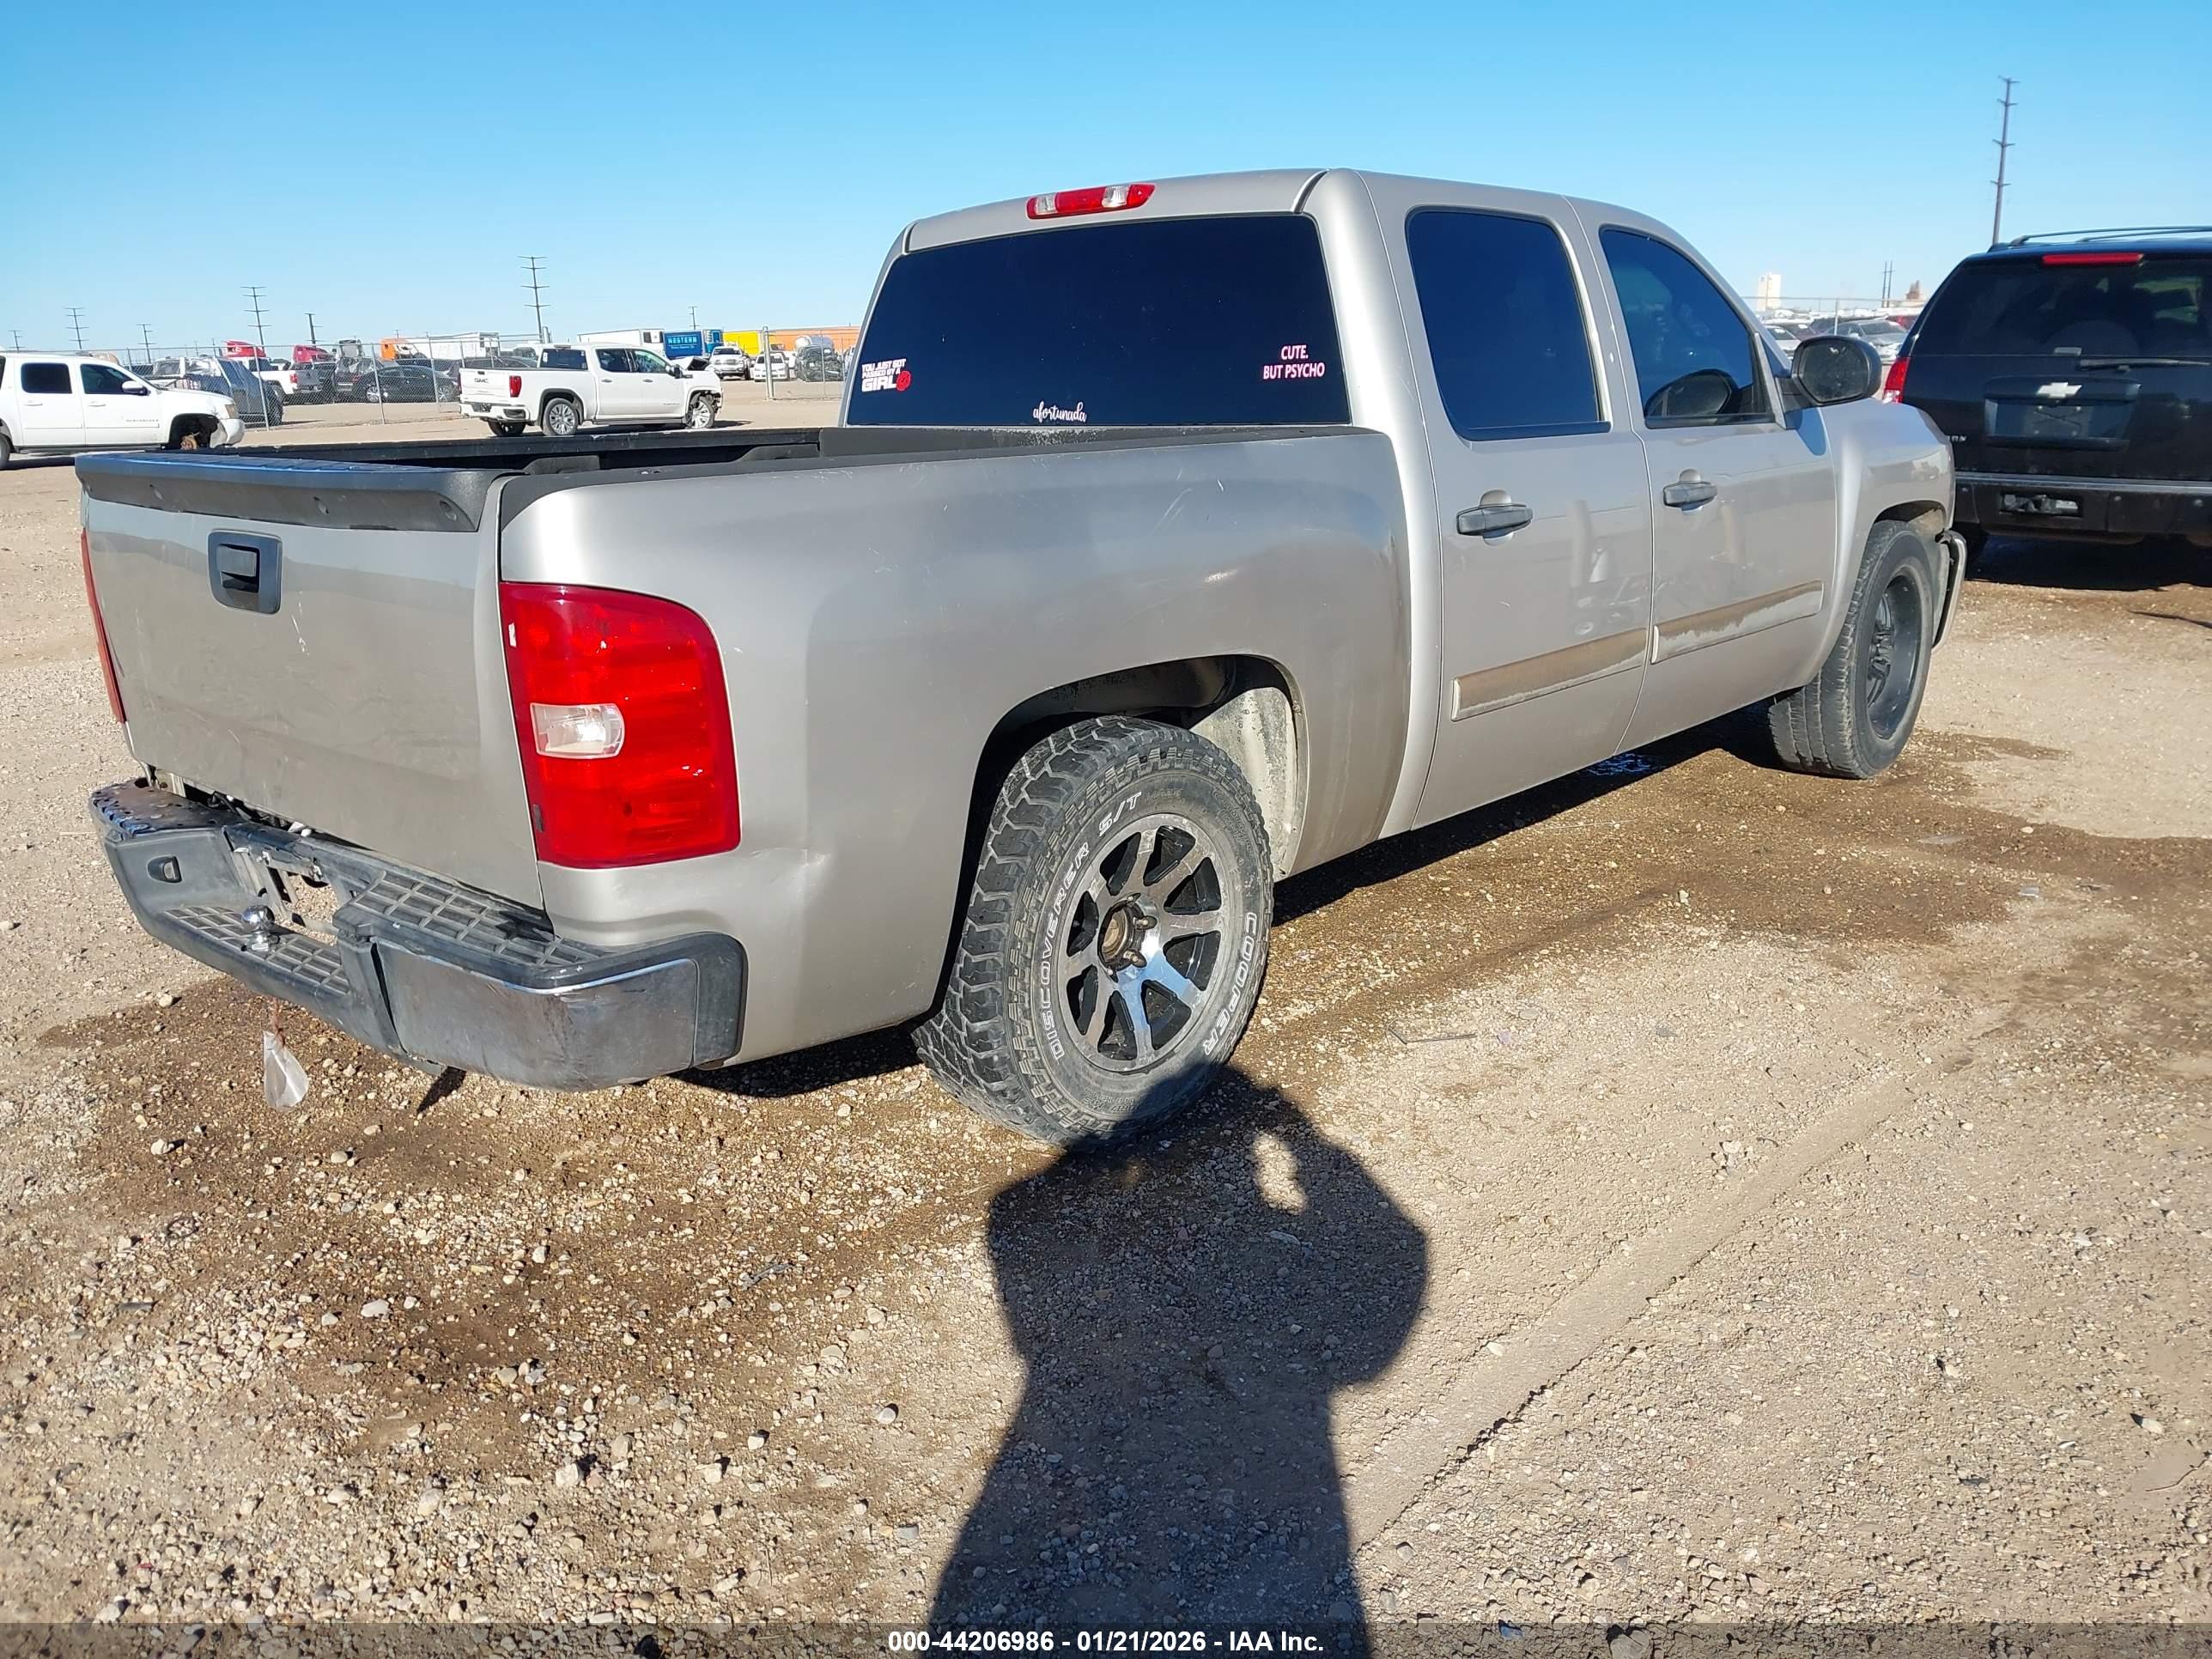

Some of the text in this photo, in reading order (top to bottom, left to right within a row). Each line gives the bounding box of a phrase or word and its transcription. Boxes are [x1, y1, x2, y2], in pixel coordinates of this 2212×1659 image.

[1280, 344, 1309, 360] CUTE.
[876, 361, 893, 370] JUST
[892, 358, 907, 368] GOT
[1263, 362, 1326, 380] BUT PSYCHO
[861, 375, 897, 392] GIRL
[1032, 400, 1087, 423] afortunada
[1040, 791, 1142, 1061] DISCOVERER S/T
[1202, 912, 1258, 1056] COOPER
